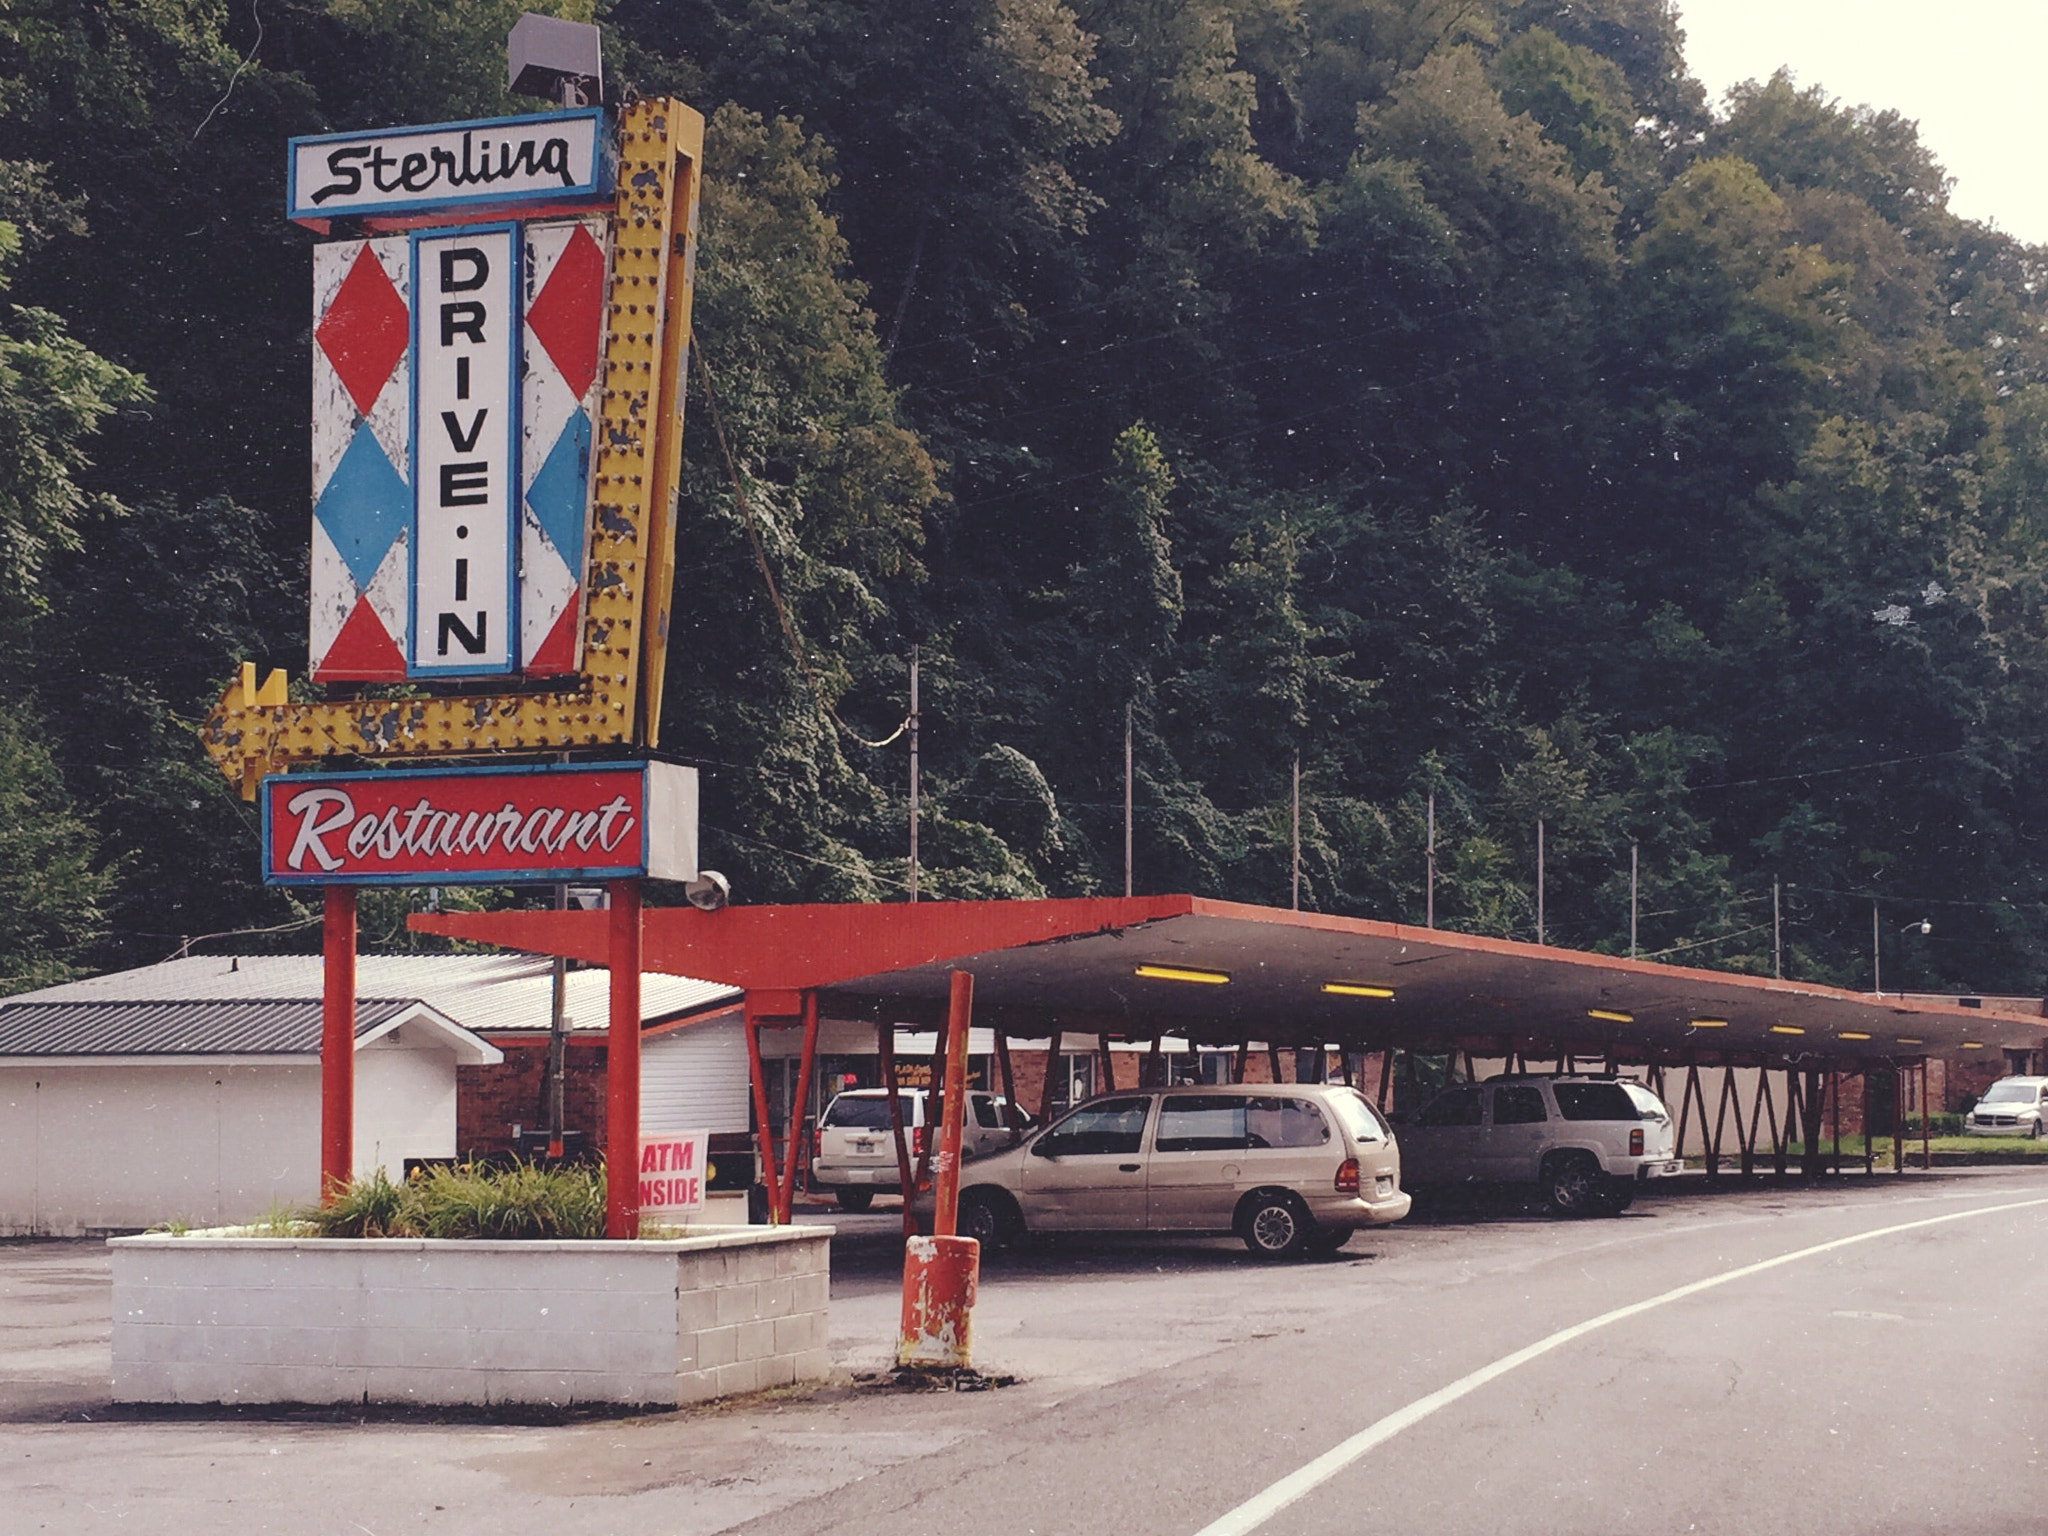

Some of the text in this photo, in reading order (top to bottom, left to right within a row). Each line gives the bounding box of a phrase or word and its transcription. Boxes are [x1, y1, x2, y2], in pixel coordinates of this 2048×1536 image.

[287, 788, 636, 871] Restaurant
[640, 1141, 694, 1173] ATM
[639, 1177, 699, 1207] NSIDE
